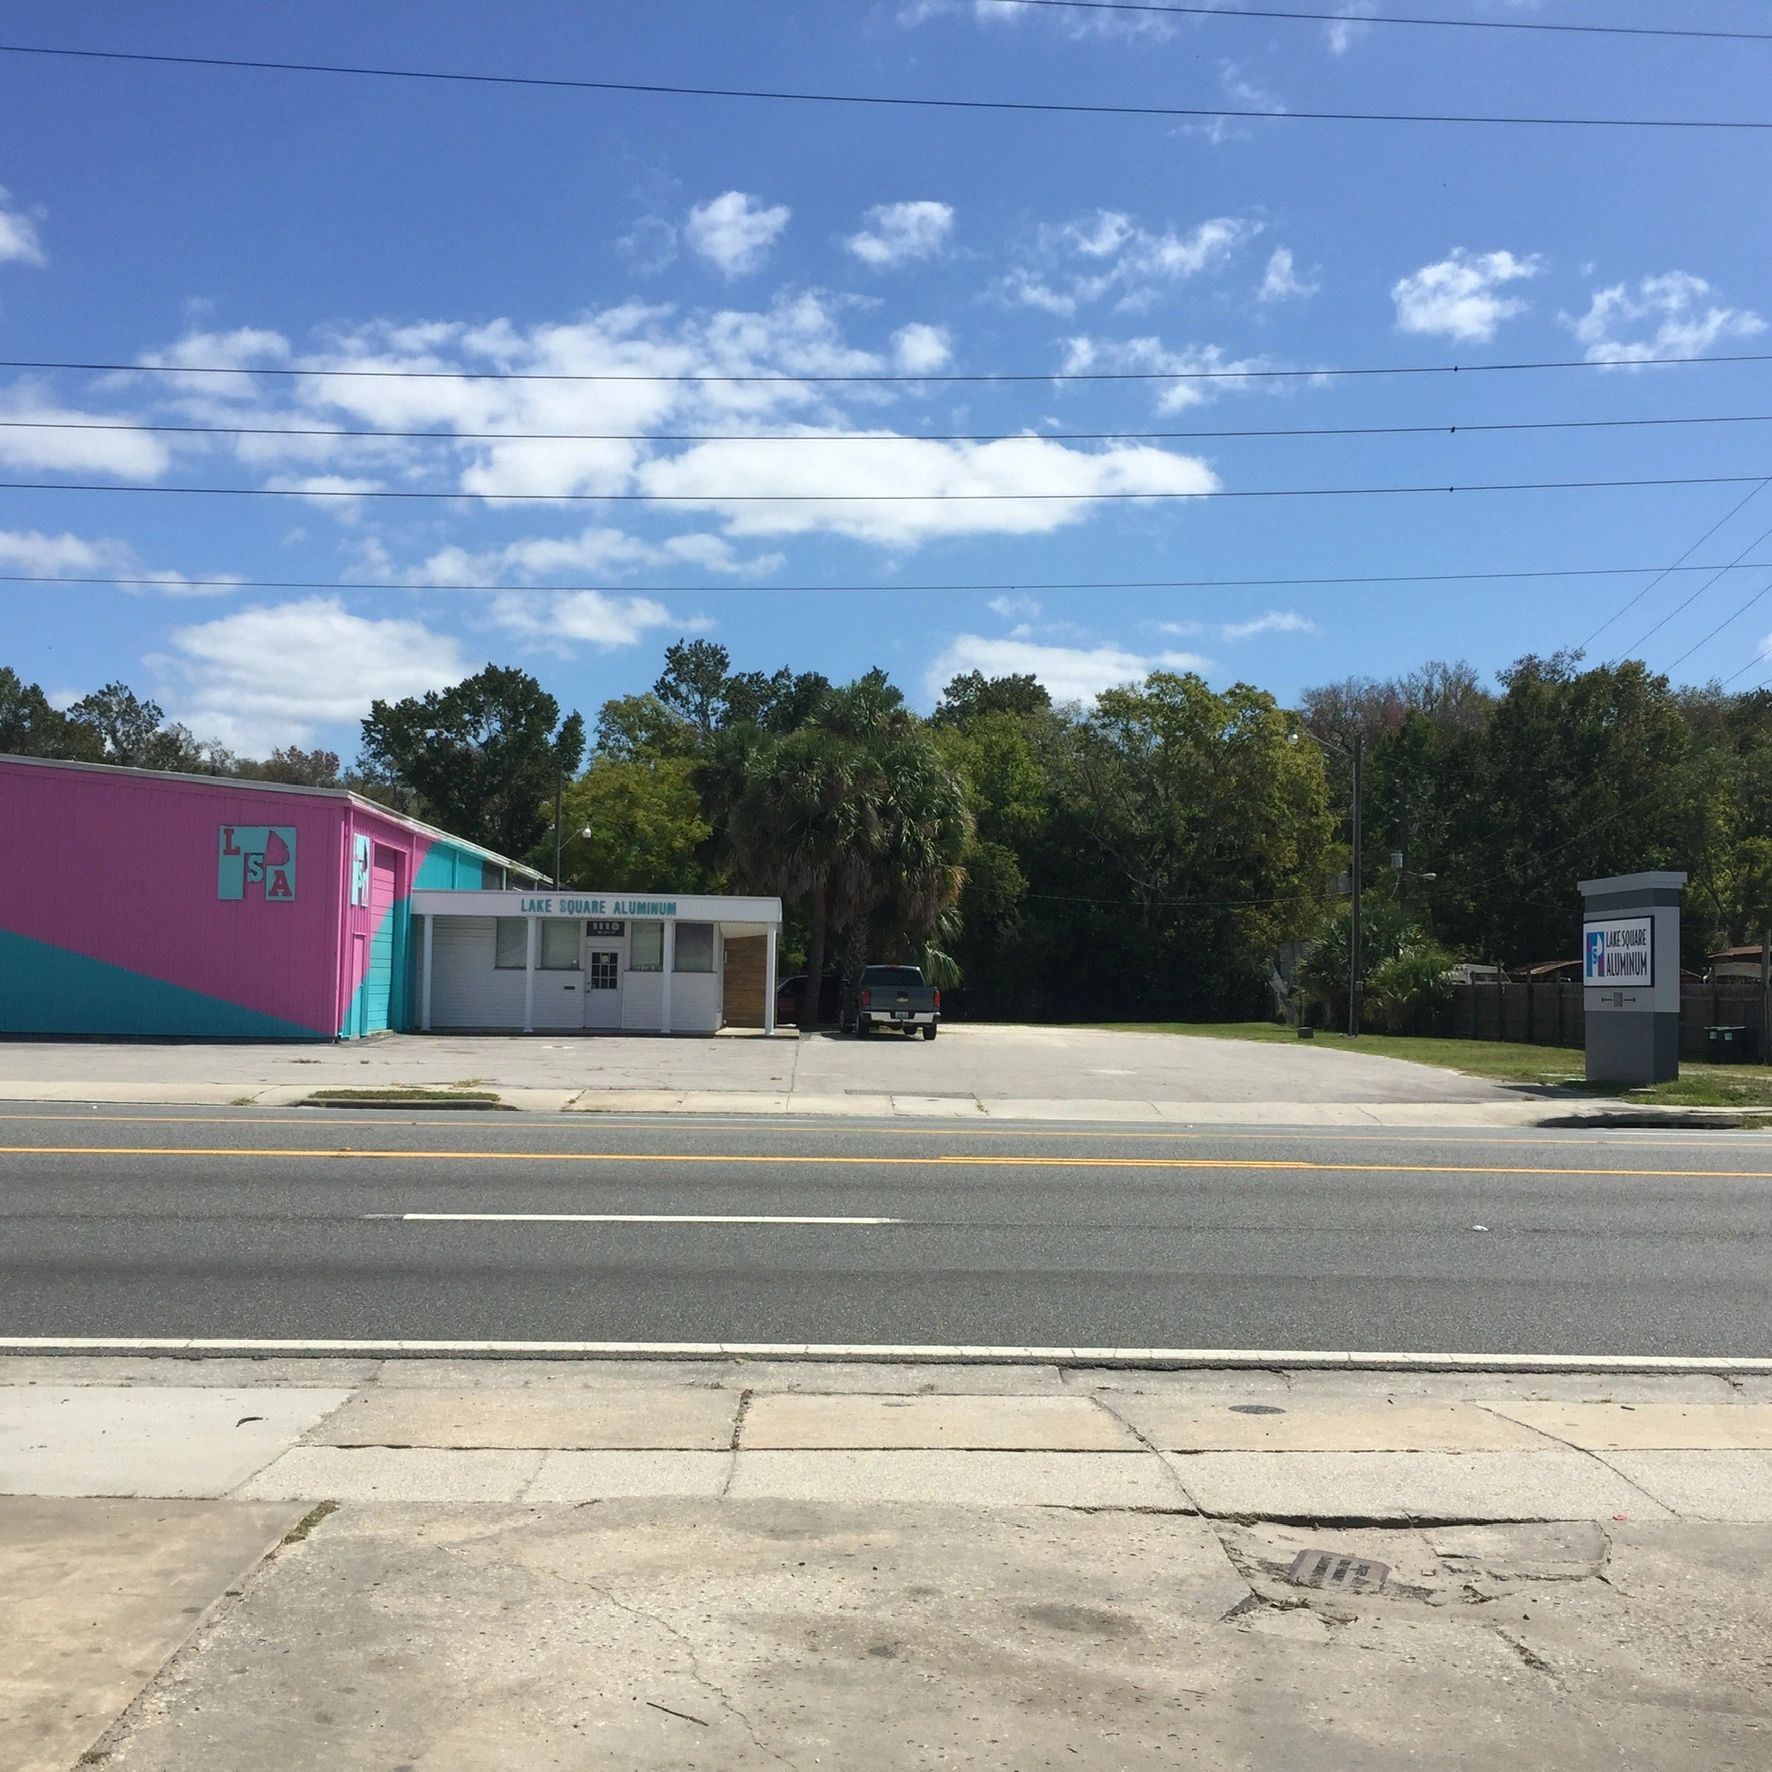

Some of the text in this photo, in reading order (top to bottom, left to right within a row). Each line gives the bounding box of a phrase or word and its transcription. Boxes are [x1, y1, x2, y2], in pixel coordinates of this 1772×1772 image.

[521, 899, 677, 915] LAKE SQUARE ALUMINUM
[1606, 928, 1647, 950] LAKE SQUARE
[1606, 952, 1647, 977] ALUMINUM
